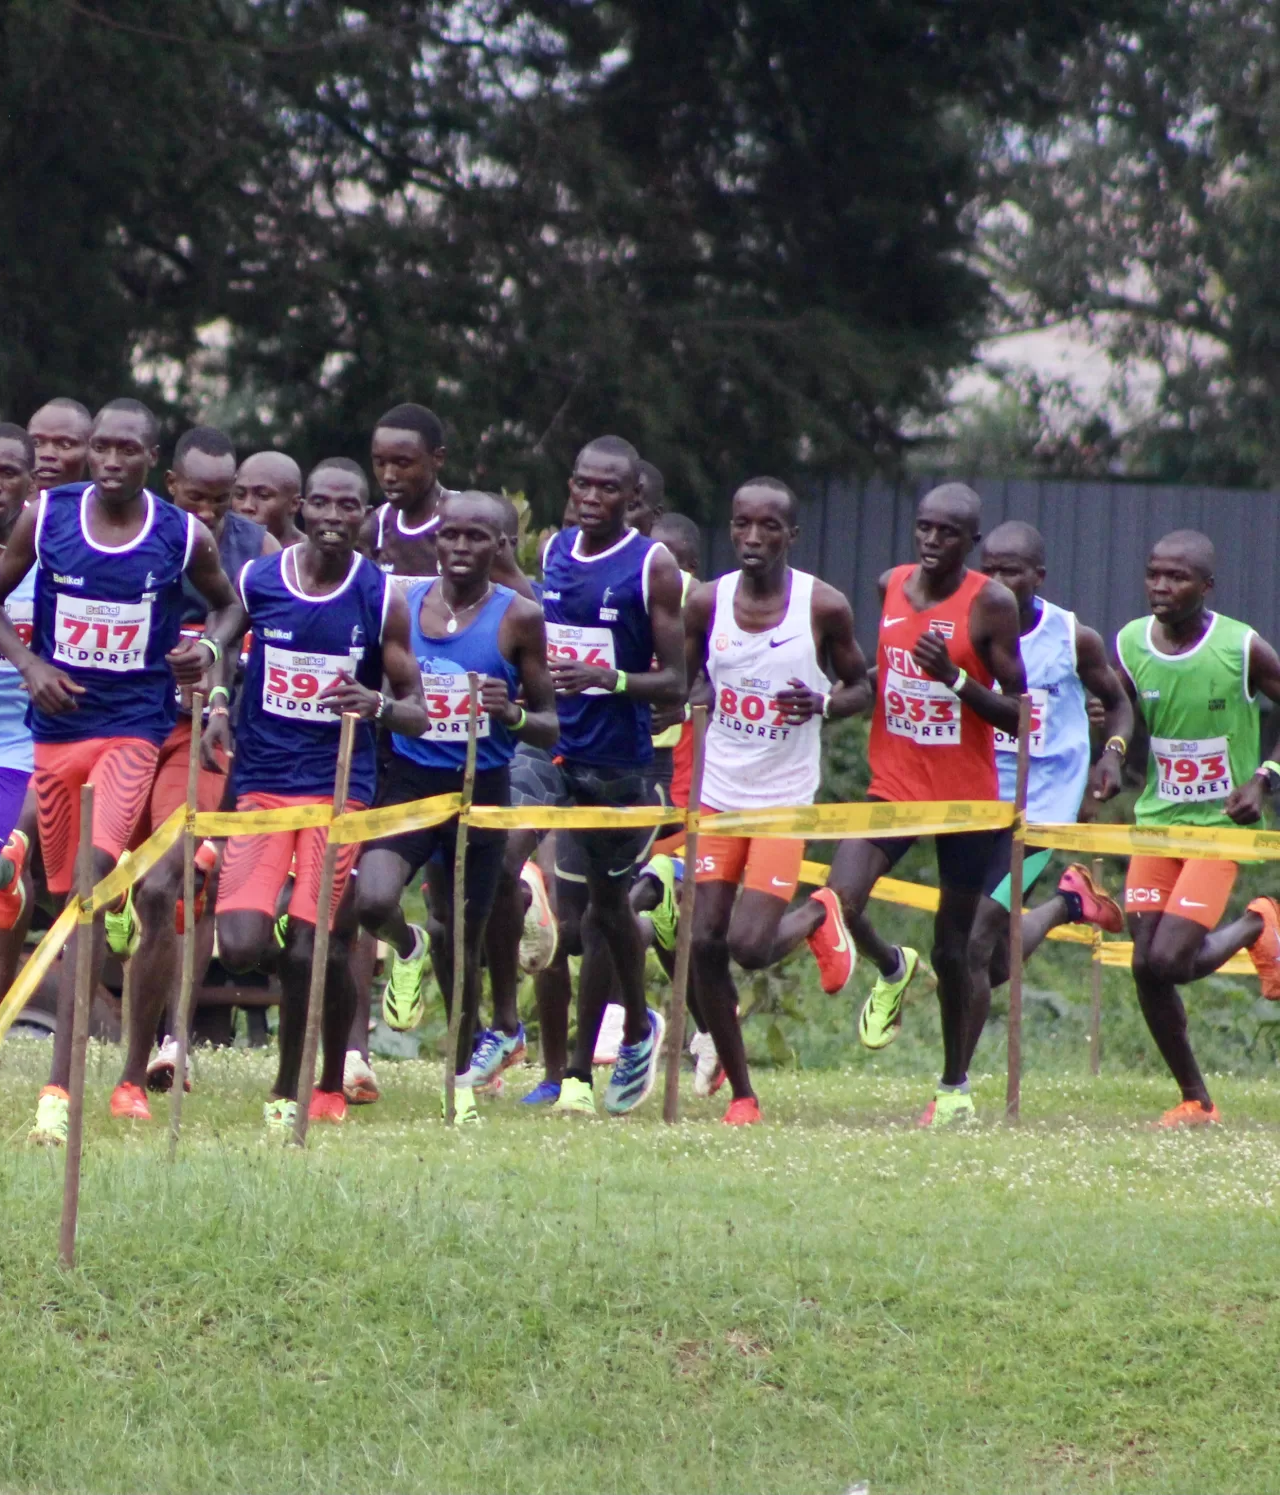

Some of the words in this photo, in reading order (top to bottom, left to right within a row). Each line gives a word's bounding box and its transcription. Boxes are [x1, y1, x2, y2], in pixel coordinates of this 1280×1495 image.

[63, 618, 140, 651] 717
[58, 644, 141, 664] ELDORET
[883, 644, 923, 677] KEN
[265, 693, 333, 714] ELDOR
[720, 688, 797, 727] 807
[886, 691, 954, 723] 933
[719, 714, 790, 740] ELDORET
[887, 714, 956, 737] ELDORET
[1157, 755, 1226, 783] 793
[1161, 780, 1230, 796] ELDORET
